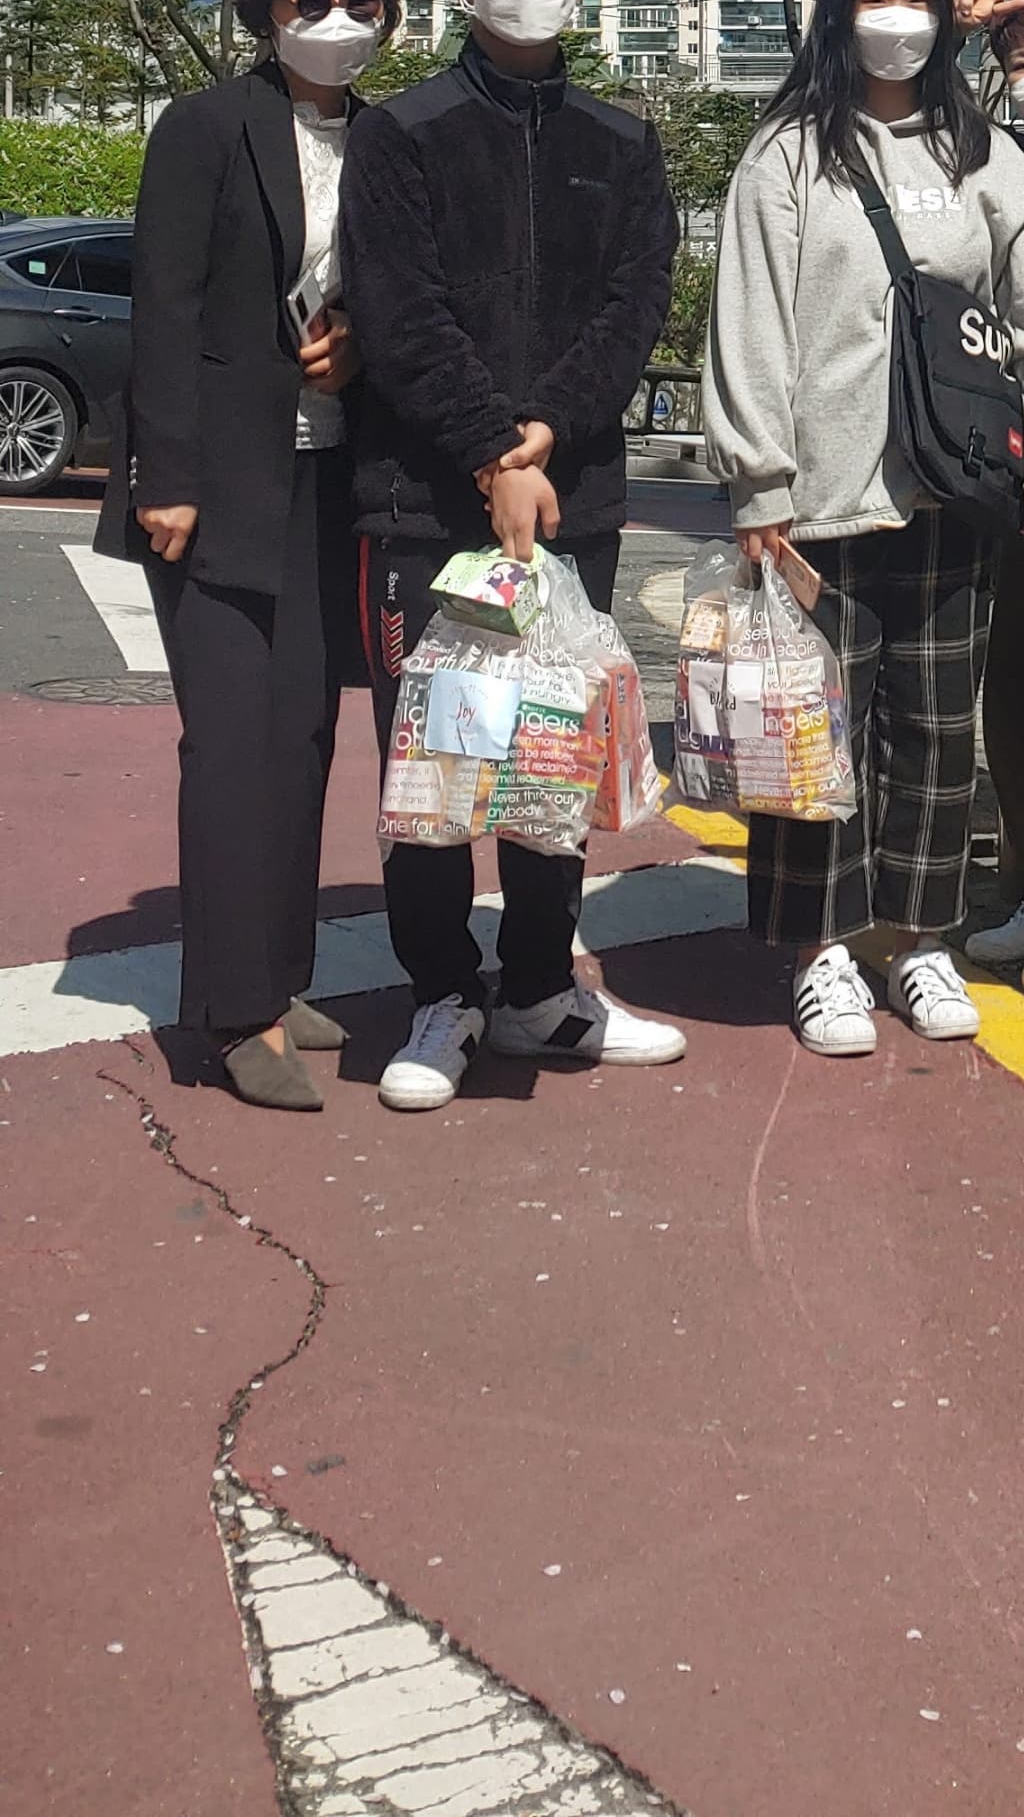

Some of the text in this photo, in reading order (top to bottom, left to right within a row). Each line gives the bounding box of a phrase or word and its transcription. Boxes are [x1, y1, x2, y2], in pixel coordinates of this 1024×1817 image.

[387, 571, 399, 601] Sport
[727, 643, 753, 657] ood
[776, 640, 817, 660] eople
[456, 702, 477, 727] Joy
[516, 707, 580, 736] ngers
[765, 711, 825, 738] ngers
[489, 791, 520, 804] Never
[411, 817, 435, 836] for
